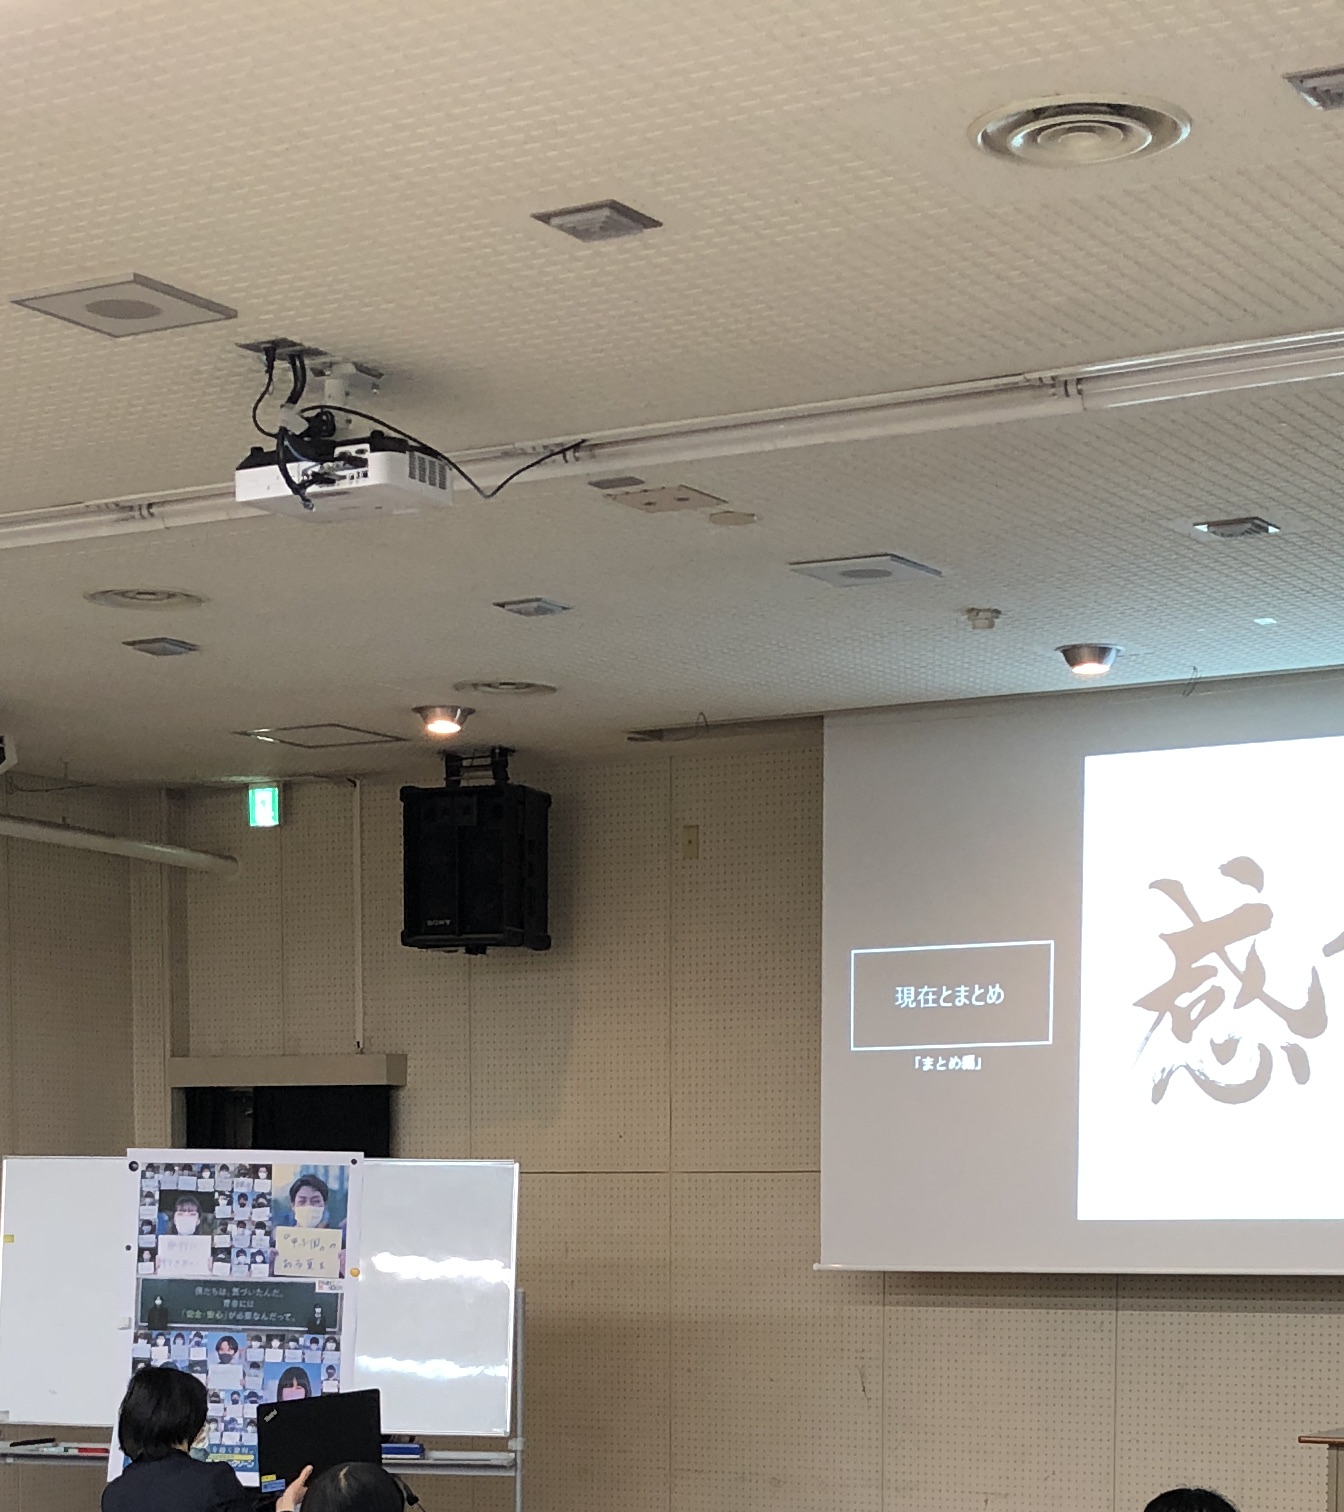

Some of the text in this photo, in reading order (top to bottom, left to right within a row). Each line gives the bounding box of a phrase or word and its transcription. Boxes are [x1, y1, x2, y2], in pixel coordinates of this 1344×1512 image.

[894, 983, 1005, 1009] 現在とまとめ
